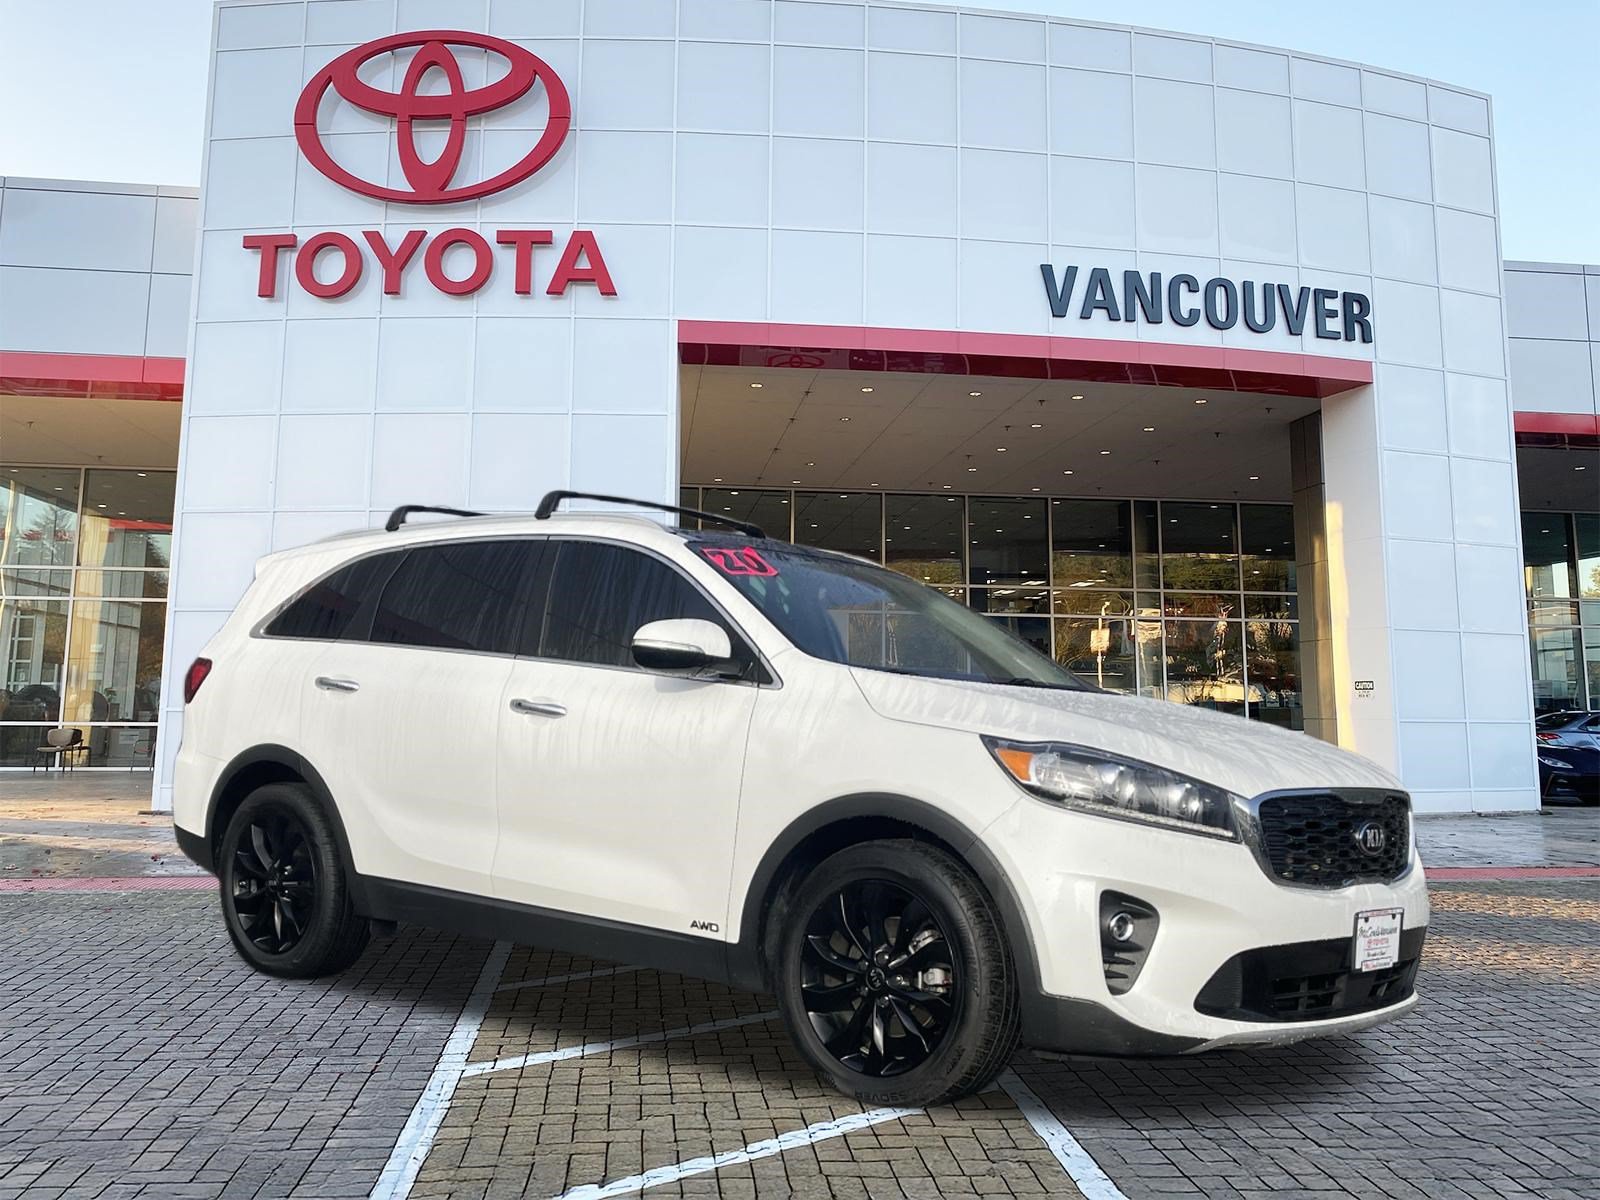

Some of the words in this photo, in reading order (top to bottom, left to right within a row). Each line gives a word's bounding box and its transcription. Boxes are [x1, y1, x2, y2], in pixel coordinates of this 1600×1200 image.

[243, 228, 617, 299] TOYOTA
[1040, 264, 1373, 343] VANCOUVER
[701, 547, 776, 576] 20
[690, 919, 719, 933] AWD
